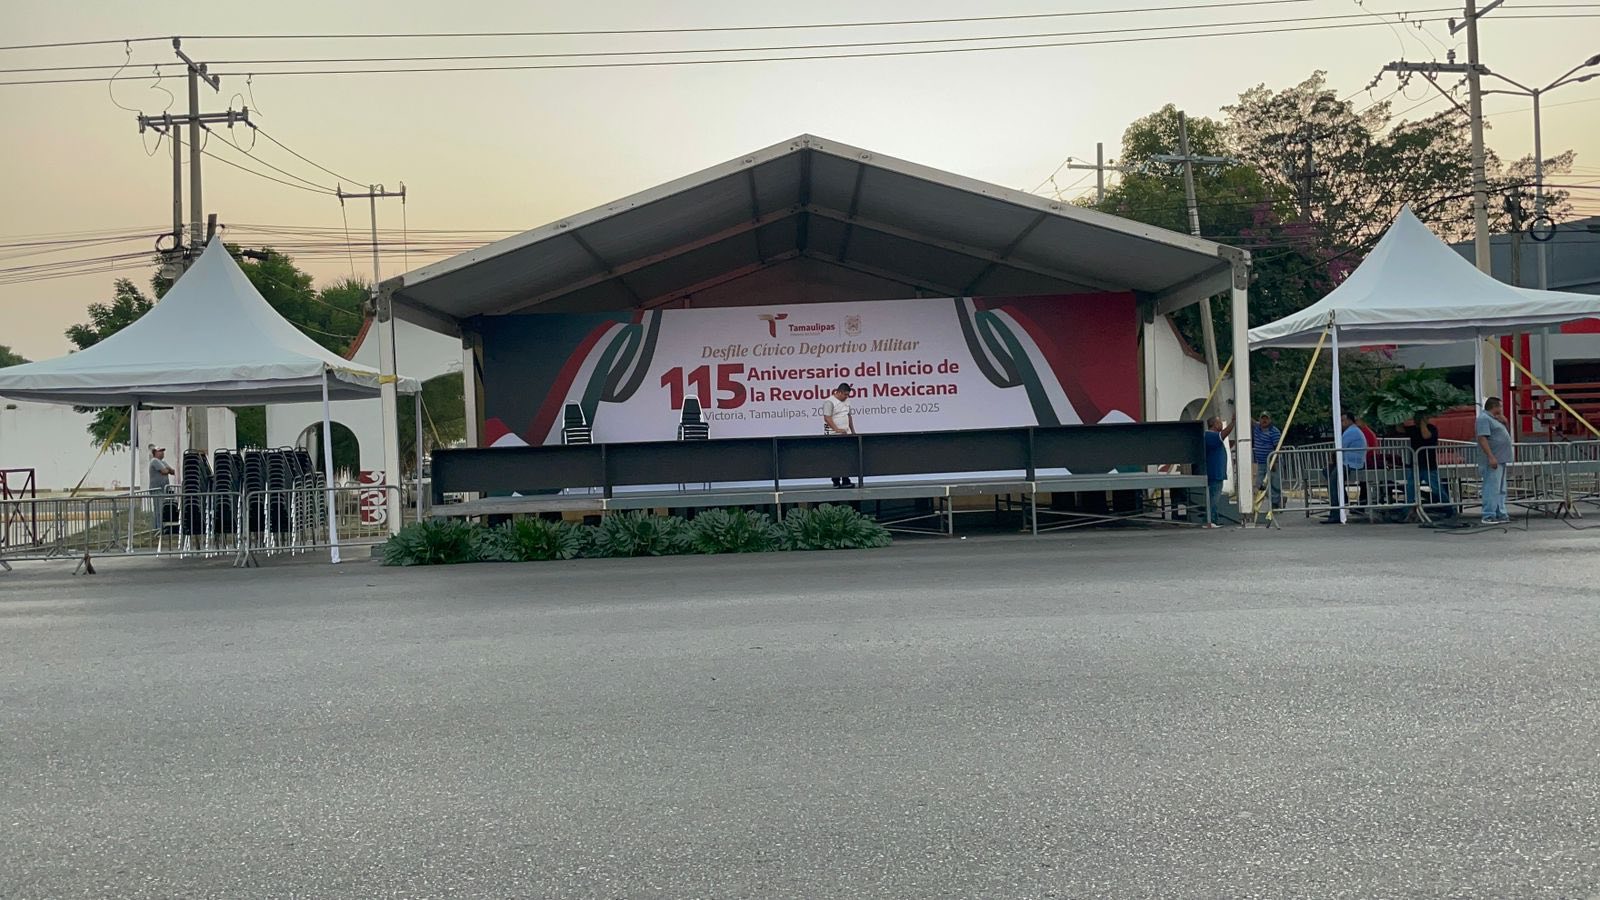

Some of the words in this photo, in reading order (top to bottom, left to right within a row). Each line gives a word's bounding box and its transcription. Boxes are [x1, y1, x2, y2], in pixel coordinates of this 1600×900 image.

[788, 323, 835, 333] Tamaulipas
[701, 344, 748, 361] Desfile
[752, 343, 795, 357] Cívico
[799, 341, 867, 358] Deportivo
[870, 339, 919, 352] Militar
[747, 364, 850, 382] Aniversario
[854, 361, 881, 377] del
[885, 360, 933, 375] Inicio
[937, 359, 959, 374] de
[660, 363, 747, 410] 115
[750, 387, 765, 402] la
[873, 381, 958, 398] Mexicana
[704, 411, 746, 421] Victoria,
[749, 407, 808, 420] Tamaulipas,
[812, 407, 824, 417] 20
[846, 404, 896, 416] oviembre
[899, 404, 913, 415] de
[915, 403, 940, 413] 2025
